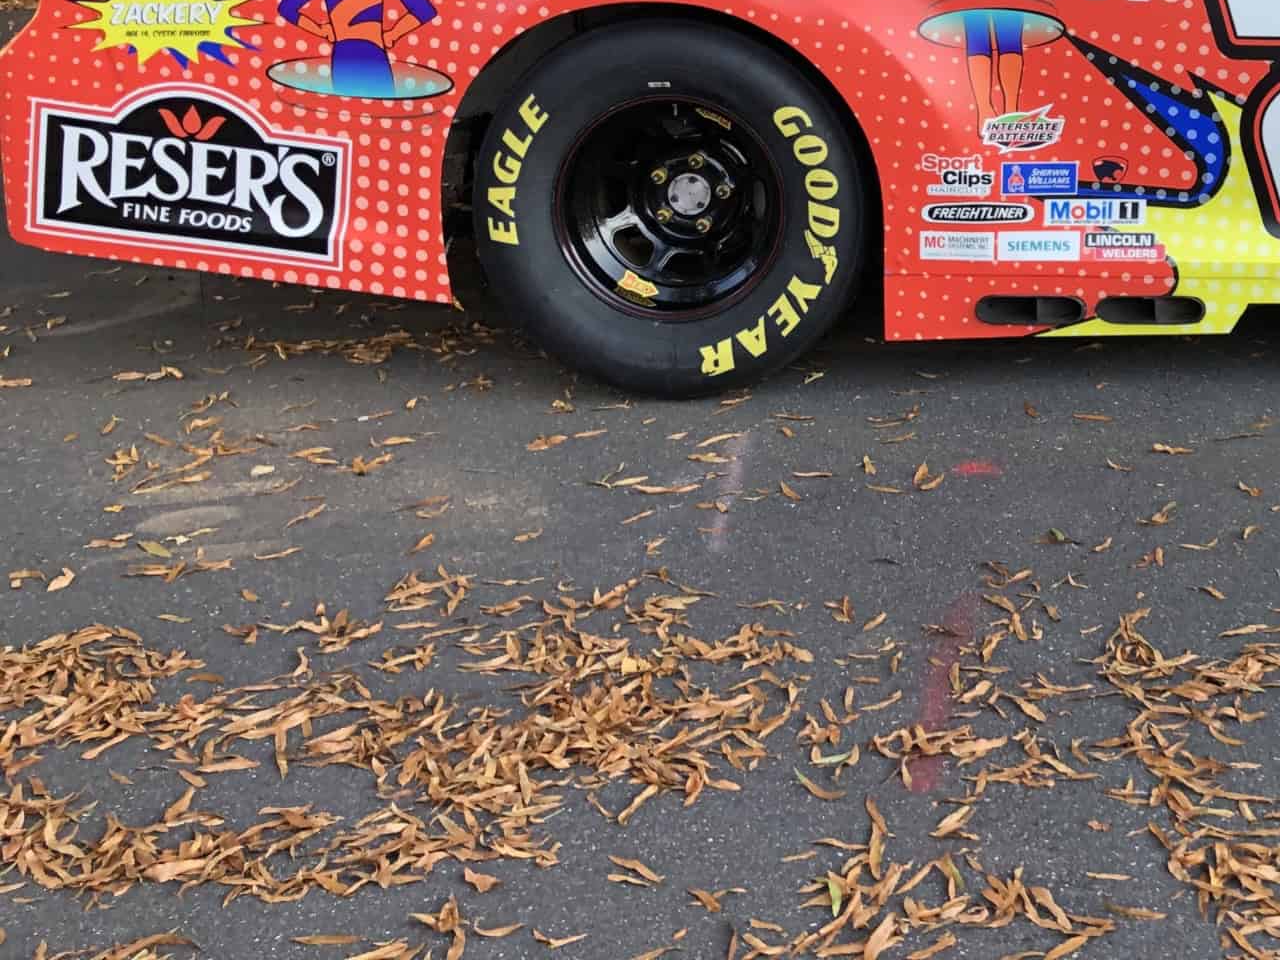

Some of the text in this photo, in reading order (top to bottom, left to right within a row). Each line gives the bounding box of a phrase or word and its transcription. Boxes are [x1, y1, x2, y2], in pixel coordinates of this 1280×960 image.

[110, 1, 222, 26] ZACKERY
[986, 122, 1058, 131] INTERSTATE
[989, 132, 1053, 141] BATTERIES
[487, 93, 550, 247] EAGLE
[922, 154, 981, 173] Sport
[57, 125, 324, 238] RESER'S
[942, 170, 993, 187] Clips
[121, 200, 253, 234] FINE FOODS
[931, 206, 1026, 220] FREIGHTLINER
[1050, 200, 1113, 220] Mobil
[924, 235, 945, 249] MC
[1007, 240, 1072, 252] SIEMENS
[1086, 233, 1153, 247] LINCOLN
[1101, 248, 1158, 259] WELDERS
